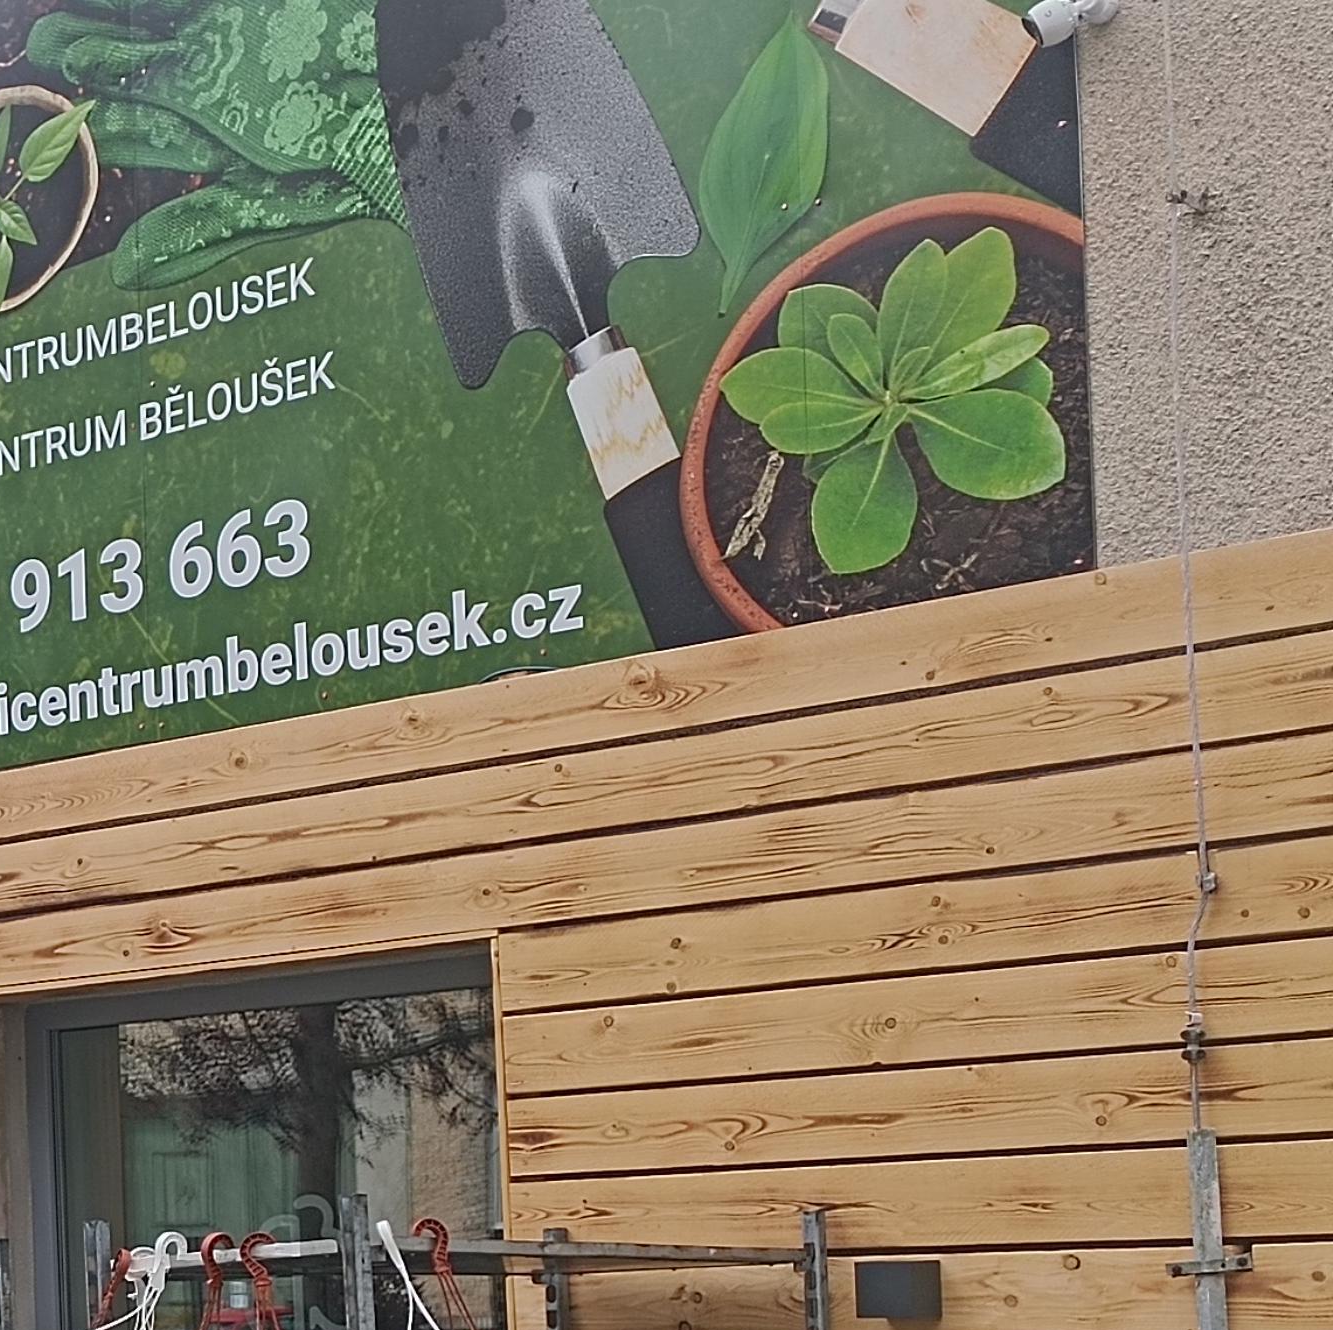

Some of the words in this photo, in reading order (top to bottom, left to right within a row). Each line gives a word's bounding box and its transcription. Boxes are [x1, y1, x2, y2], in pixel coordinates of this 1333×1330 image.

[139, 351, 336, 441] BĚLOUŠEK
[10, 536, 145, 634] 913
[170, 498, 312, 599] 663
